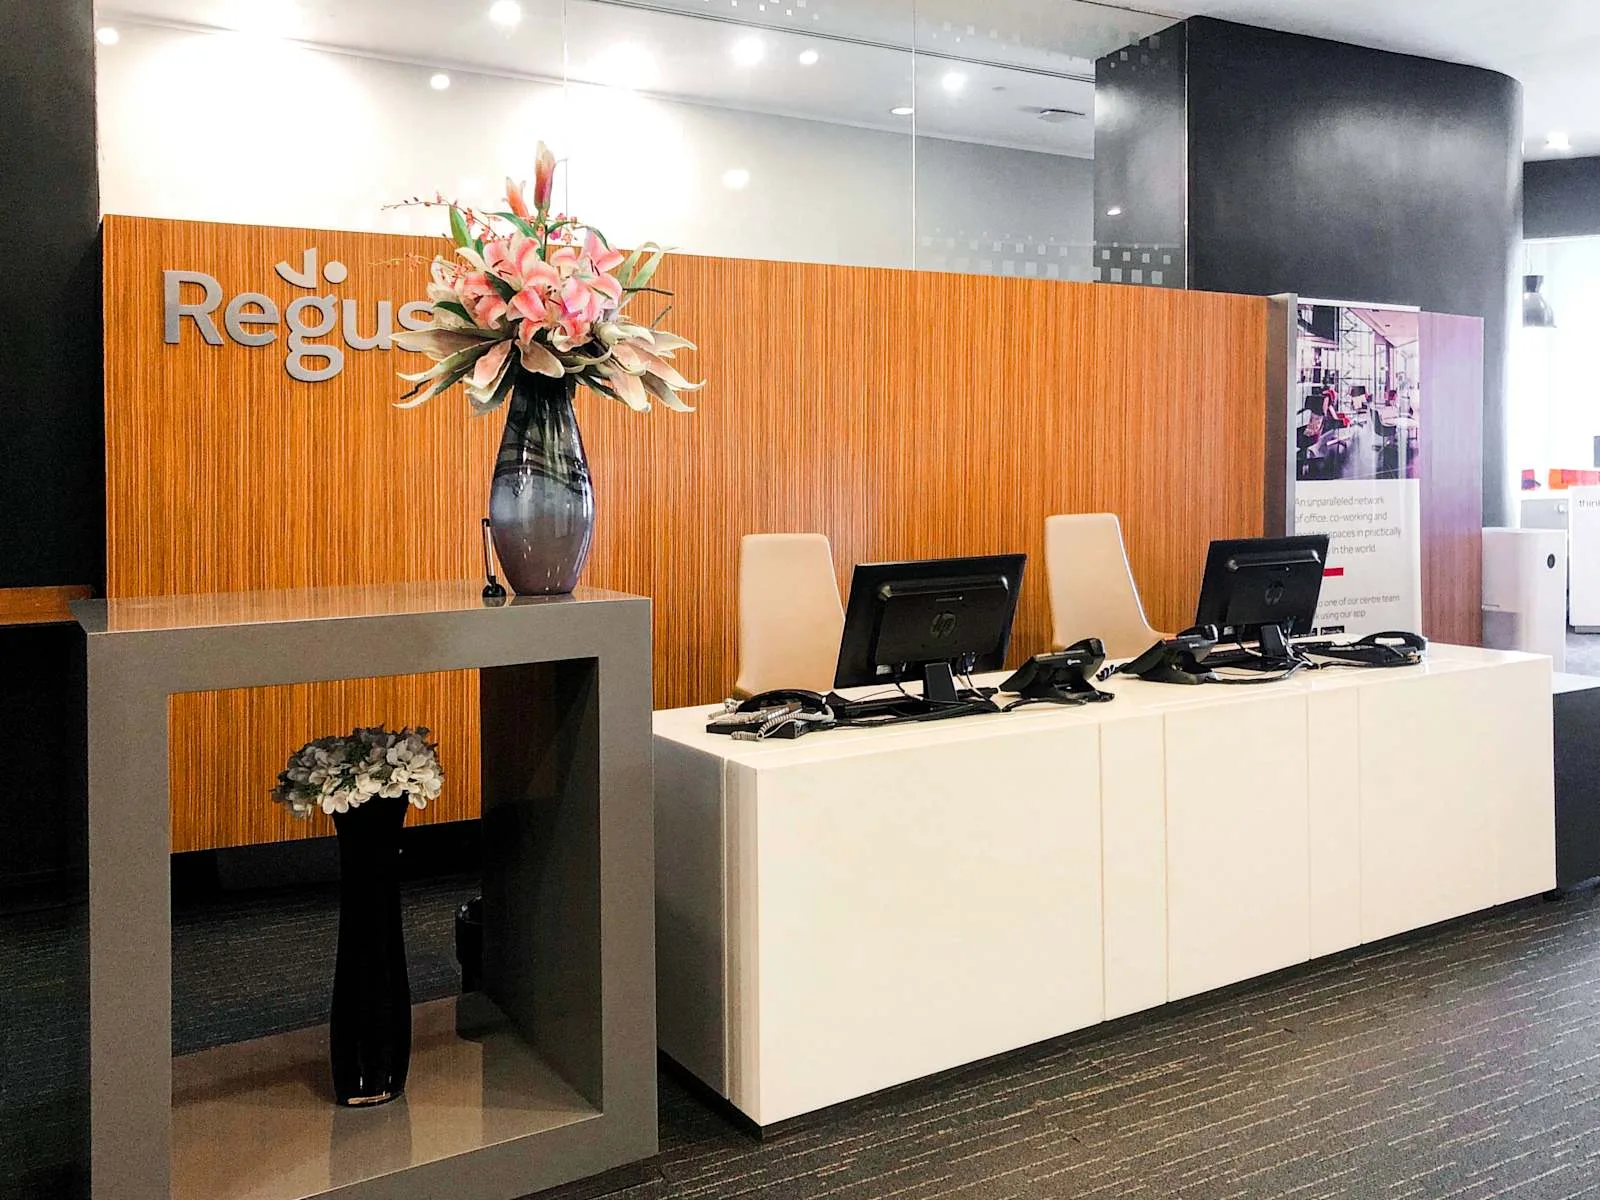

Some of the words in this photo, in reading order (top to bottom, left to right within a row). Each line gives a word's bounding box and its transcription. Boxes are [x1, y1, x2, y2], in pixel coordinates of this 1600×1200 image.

[163, 269, 437, 382] Regus
[1307, 497, 1353, 508] unparalleled
[1355, 495, 1384, 505] network
[1330, 512, 1373, 524] co-working
[1374, 511, 1387, 521] and
[1328, 530, 1355, 540] spaces
[1357, 528, 1363, 537] in
[1365, 527, 1401, 538] practically
[1333, 545, 1339, 554] in
[1340, 545, 1353, 554] the
[1355, 544, 1376, 553] world
[1324, 599, 1337, 608] one
[1338, 597, 1346, 606] of
[1320, 612, 1339, 621] using
[1340, 610, 1352, 618] our
[1353, 610, 1366, 619] app
